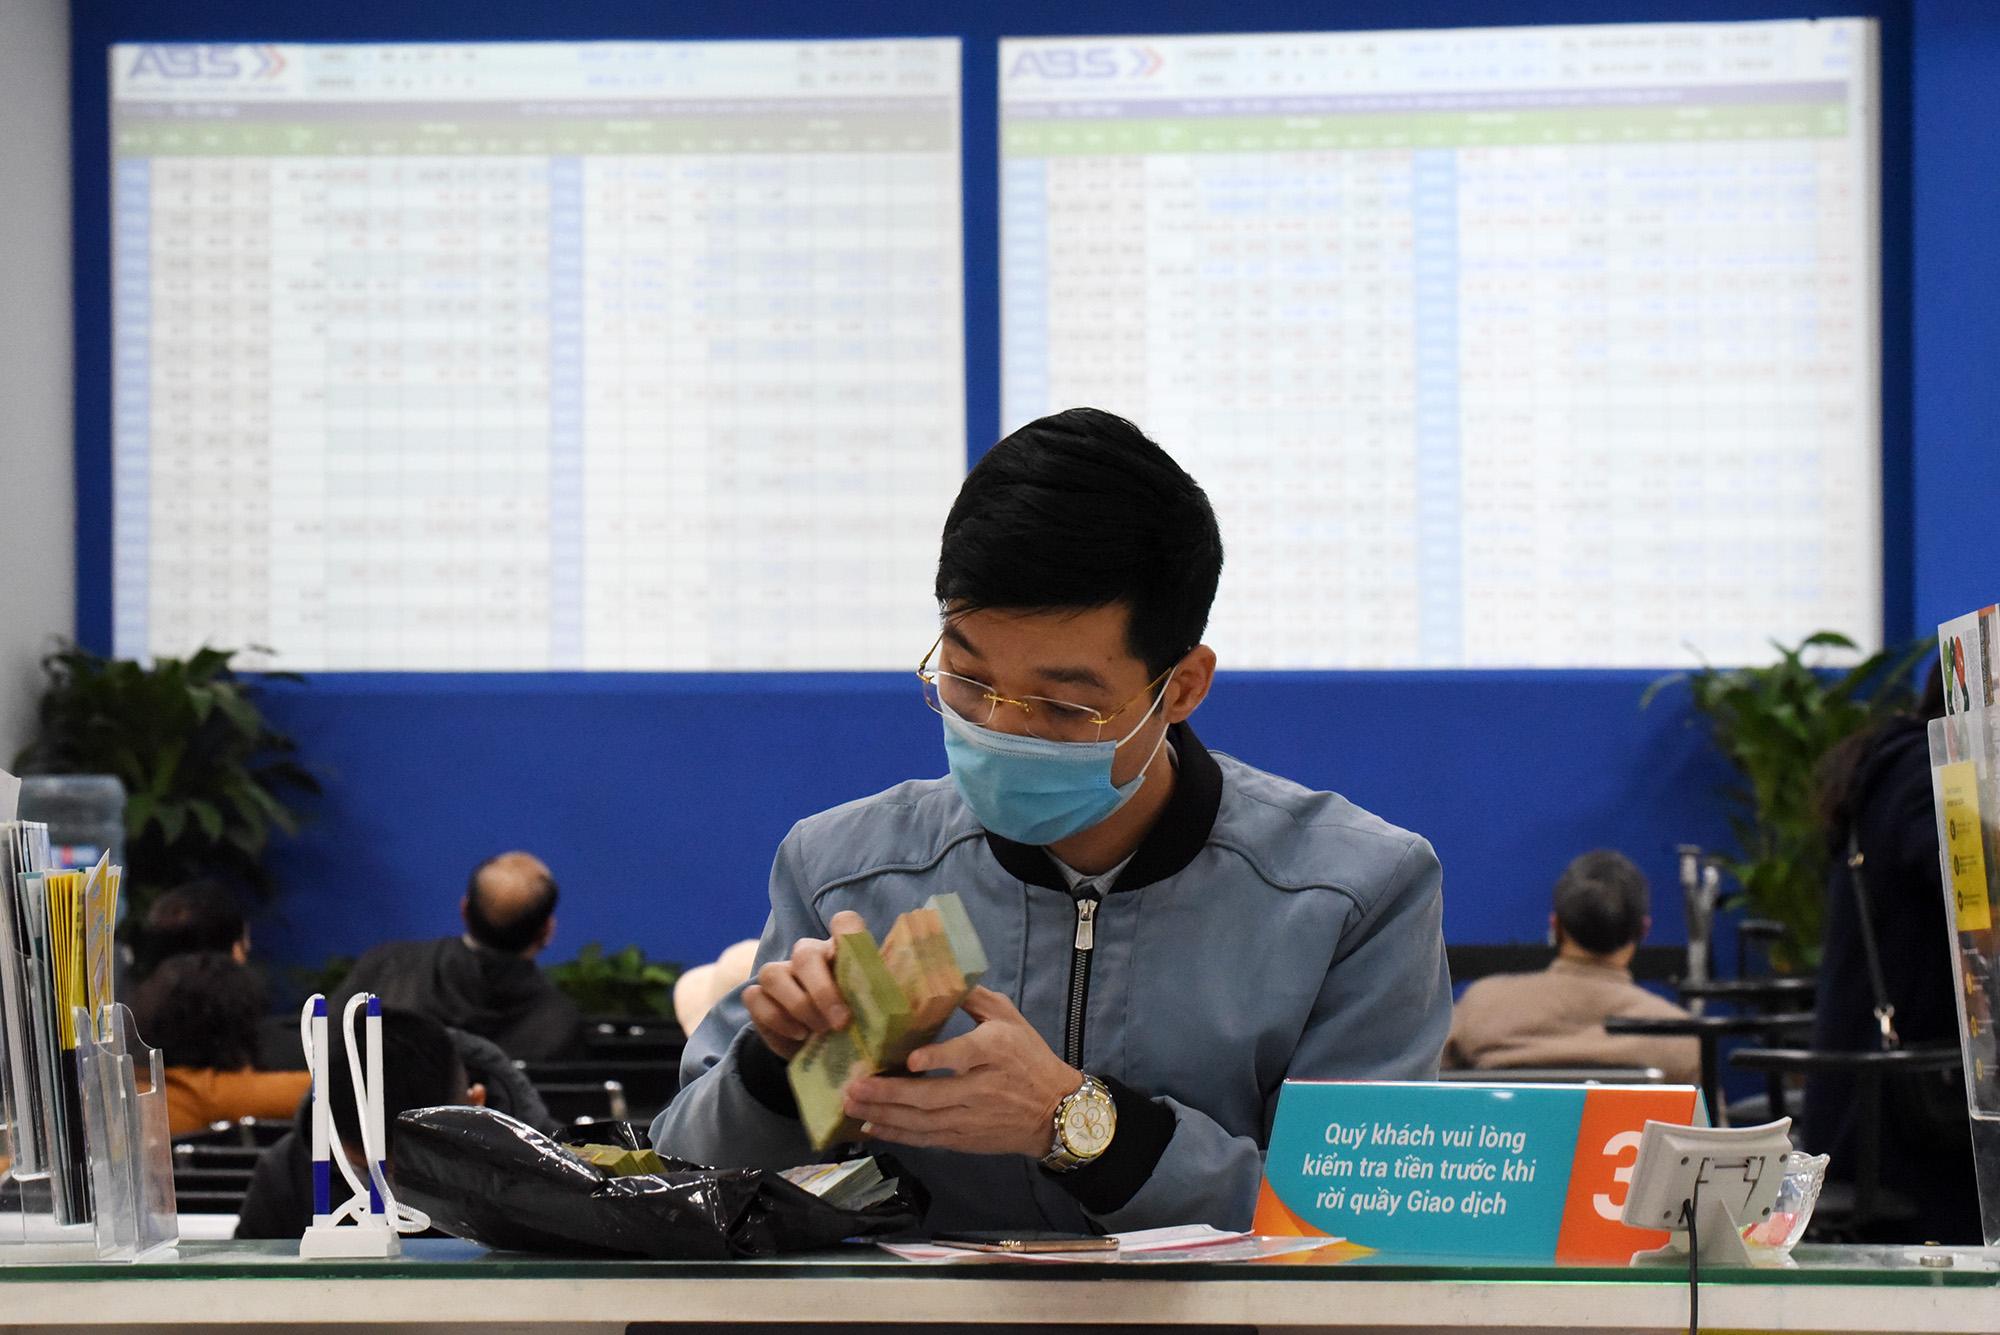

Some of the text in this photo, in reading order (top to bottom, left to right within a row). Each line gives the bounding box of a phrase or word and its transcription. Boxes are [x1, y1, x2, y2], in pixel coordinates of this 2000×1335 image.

[1324, 1122, 1527, 1154] Quý khách vui lòng
[1302, 1152, 1537, 1182] kiểm tra tiền trước khi
[1316, 1186, 1507, 1218] rời quầy Giao dịch
